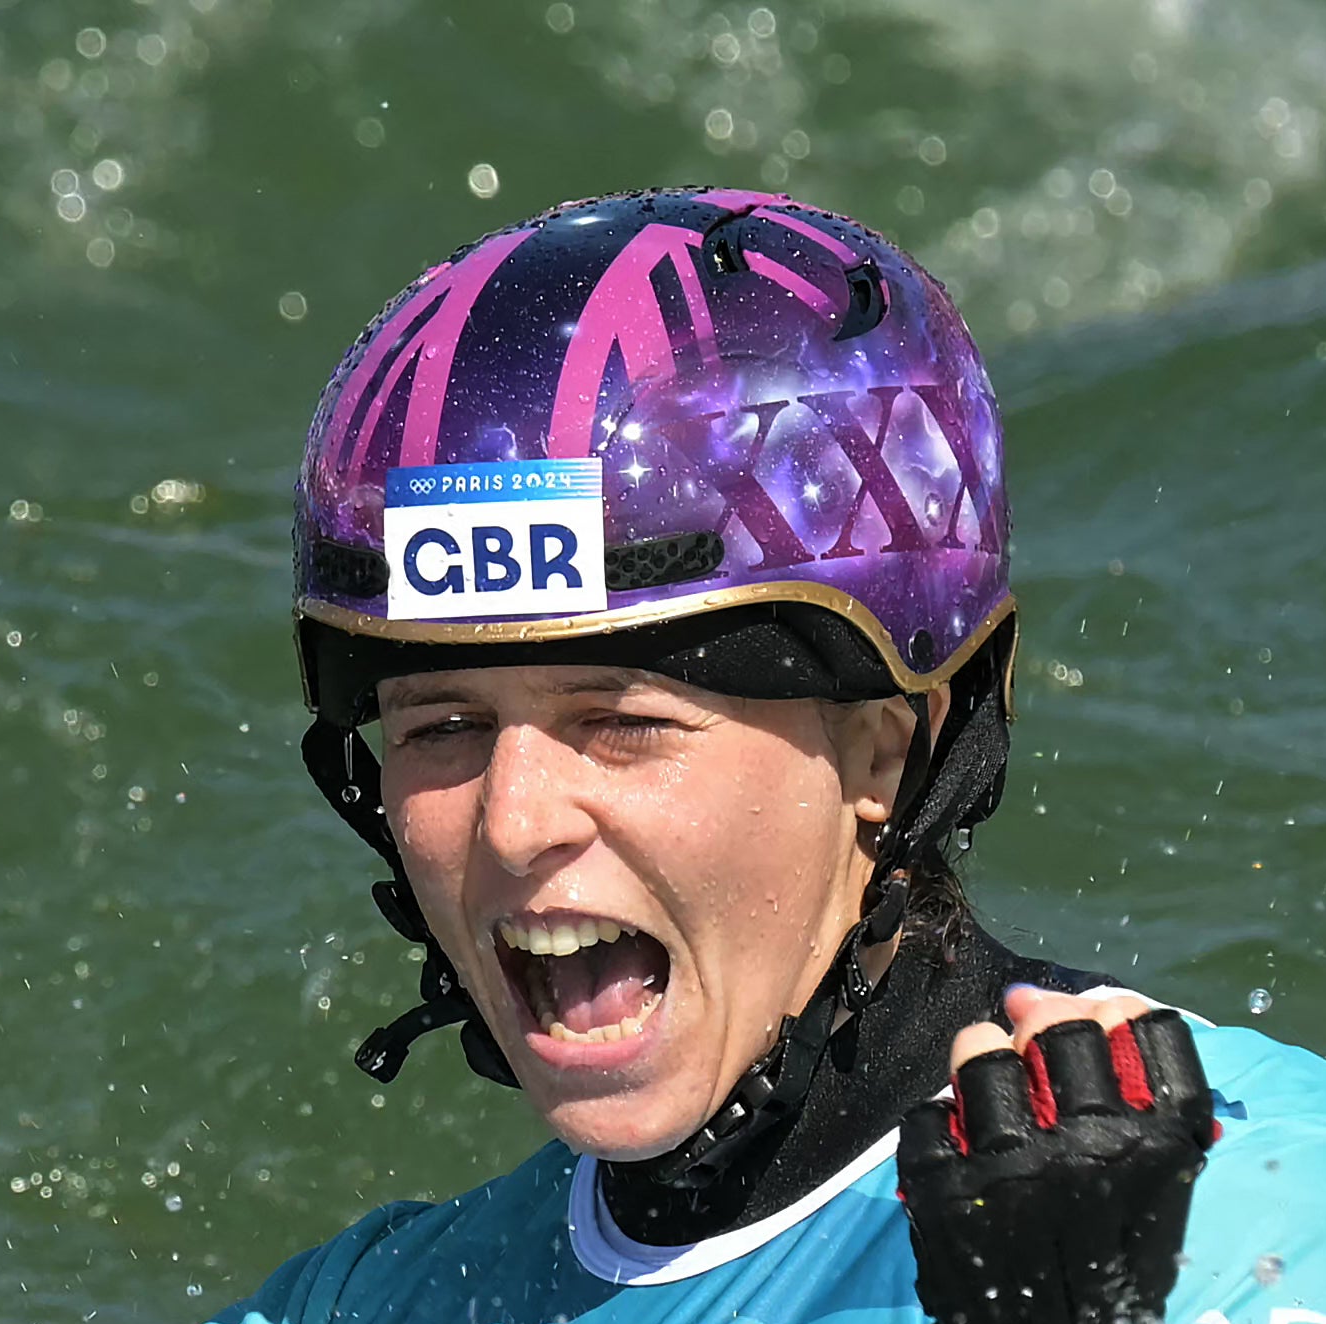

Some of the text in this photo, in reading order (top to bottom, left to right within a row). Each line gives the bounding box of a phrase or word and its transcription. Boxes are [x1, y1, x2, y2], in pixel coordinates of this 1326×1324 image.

[441, 471, 571, 493] PARIS 2024
[403, 523, 583, 597] GBR
